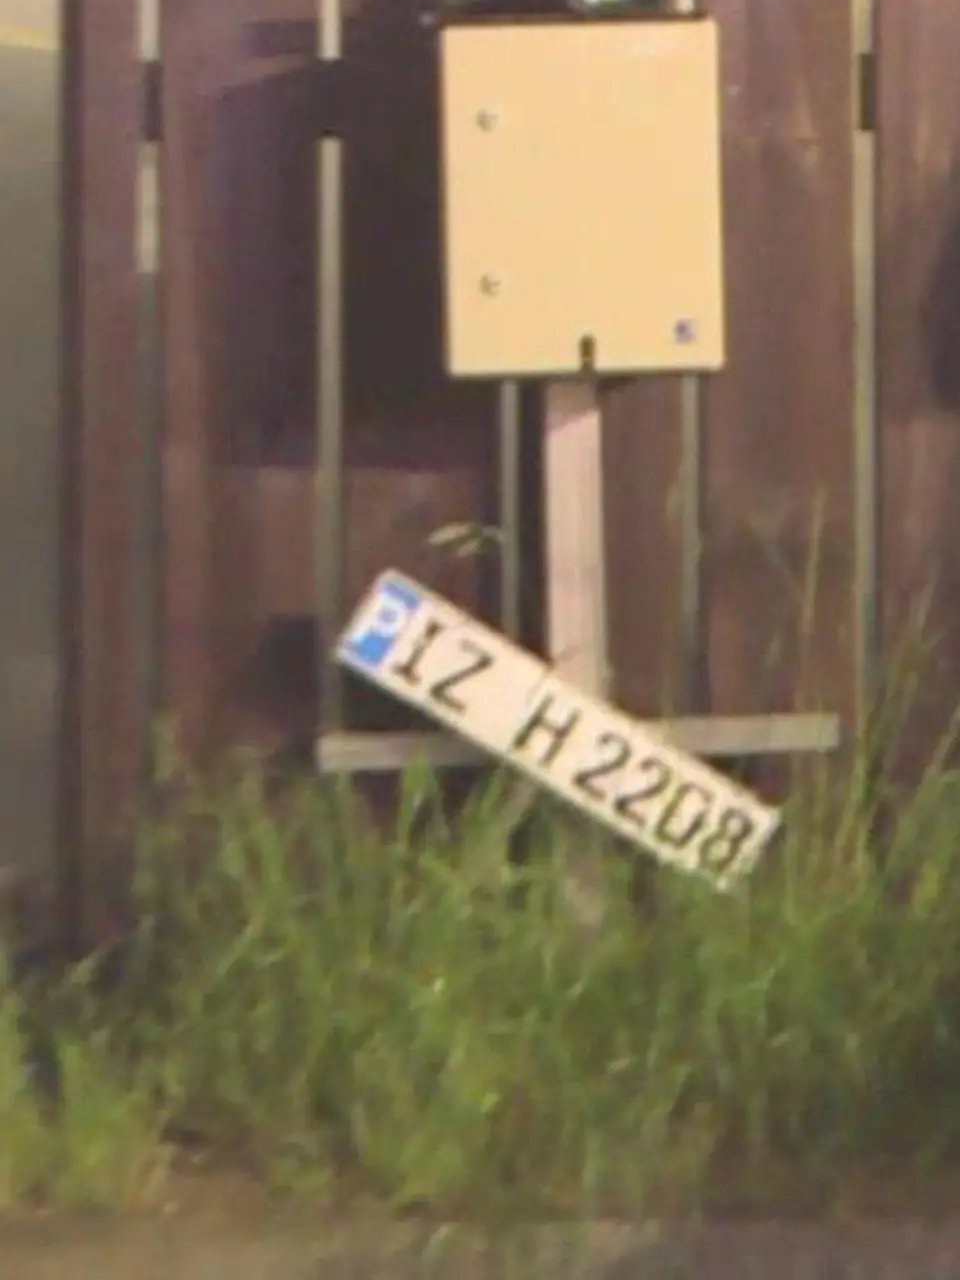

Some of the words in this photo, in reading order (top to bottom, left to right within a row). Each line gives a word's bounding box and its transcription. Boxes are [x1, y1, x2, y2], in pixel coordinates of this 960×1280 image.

[391, 618, 495, 714] IZ
[512, 695, 583, 769] H
[572, 731, 754, 873] 2208
